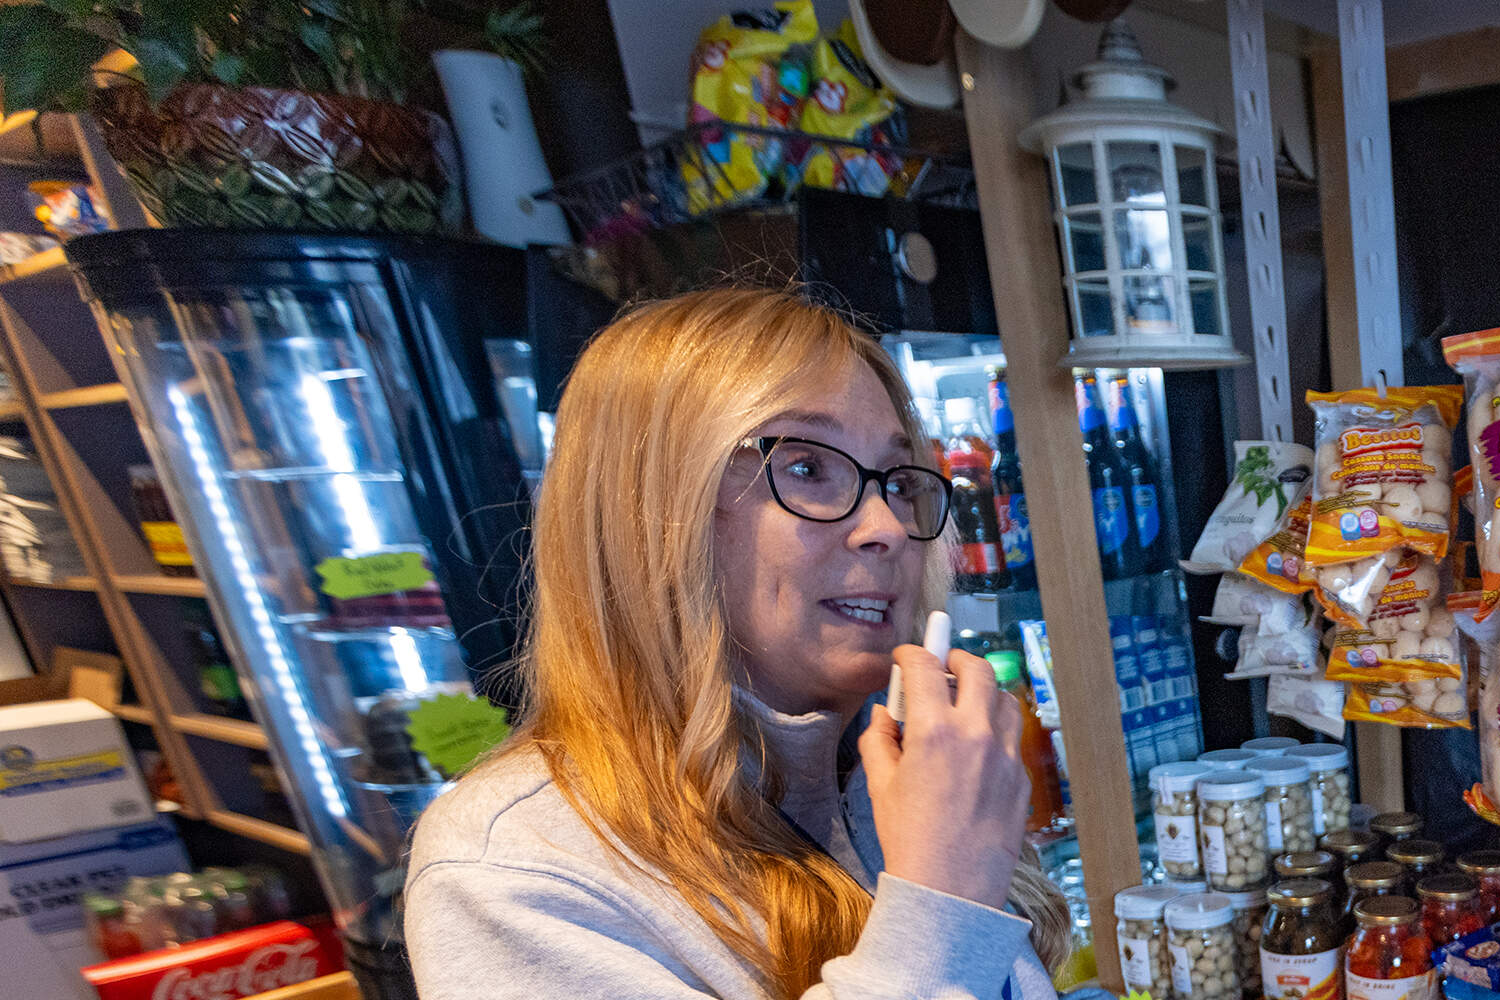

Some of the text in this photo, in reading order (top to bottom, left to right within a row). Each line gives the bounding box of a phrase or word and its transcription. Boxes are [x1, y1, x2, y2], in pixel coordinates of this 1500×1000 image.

[1345, 427, 1421, 450] Besitos
[1343, 452, 1422, 466] Cassava Snacks
